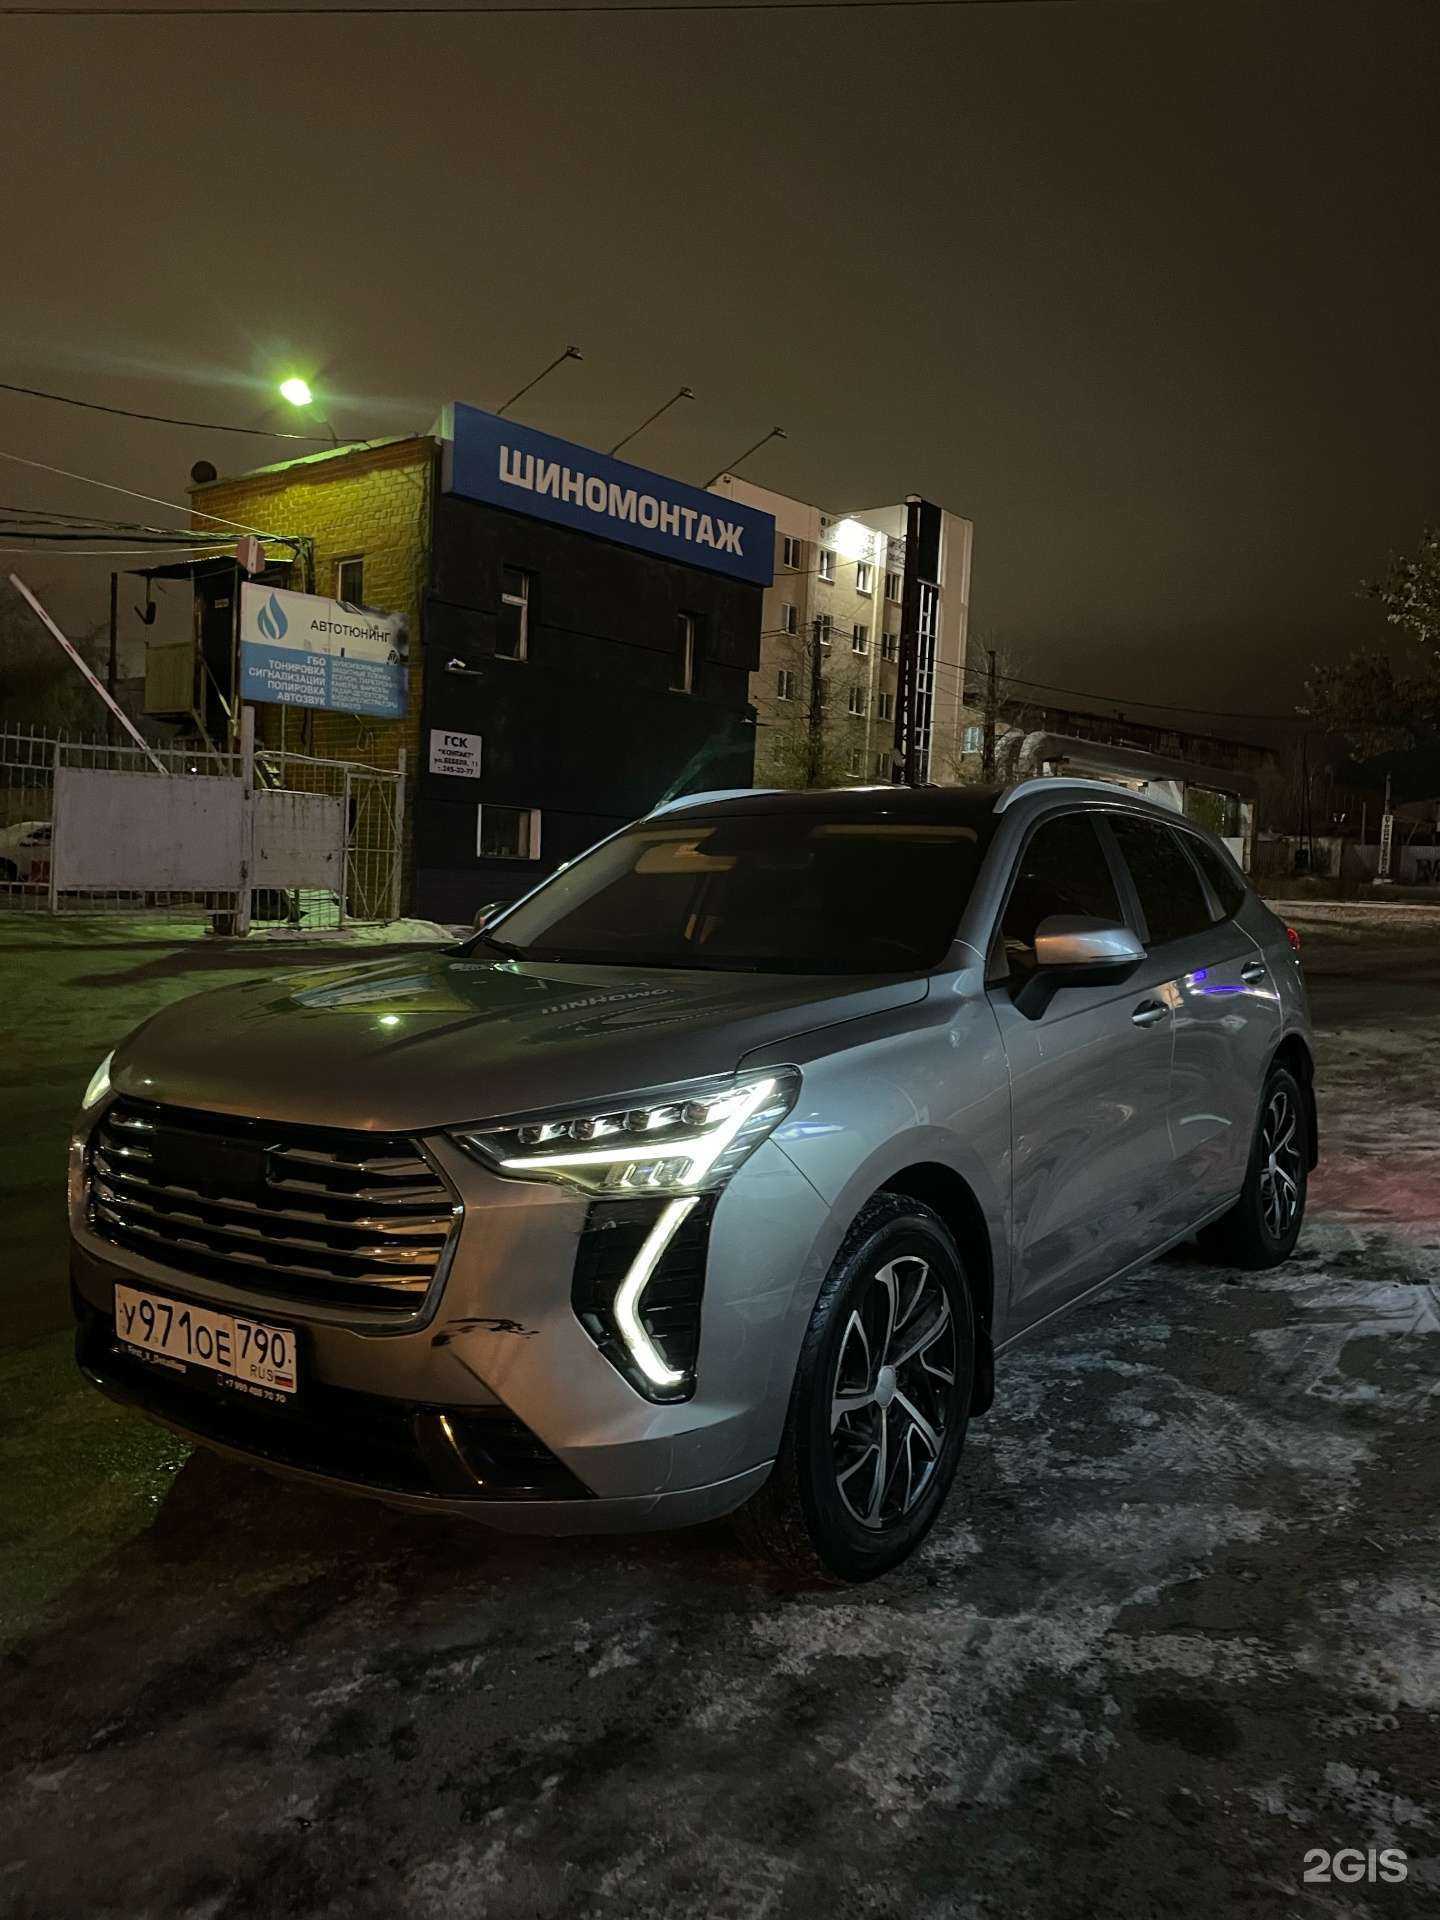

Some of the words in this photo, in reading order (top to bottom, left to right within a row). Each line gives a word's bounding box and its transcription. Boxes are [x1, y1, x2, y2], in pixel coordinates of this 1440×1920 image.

[499, 445, 744, 556] ШИНОМОНТАЖ
[268, 660, 326, 677] ТОНИРОВКА
[306, 655, 326, 667] ГБО
[249, 667, 326, 687] СИГНАЛИЗАЦИИ
[267, 680, 326, 696] ПОЛИРОВКА
[276, 692, 326, 706] АВТОЗВУК
[444, 735, 468, 748] ГСК
[237, 1323, 286, 1369] 790
[249, 1363, 275, 1383] RUS
